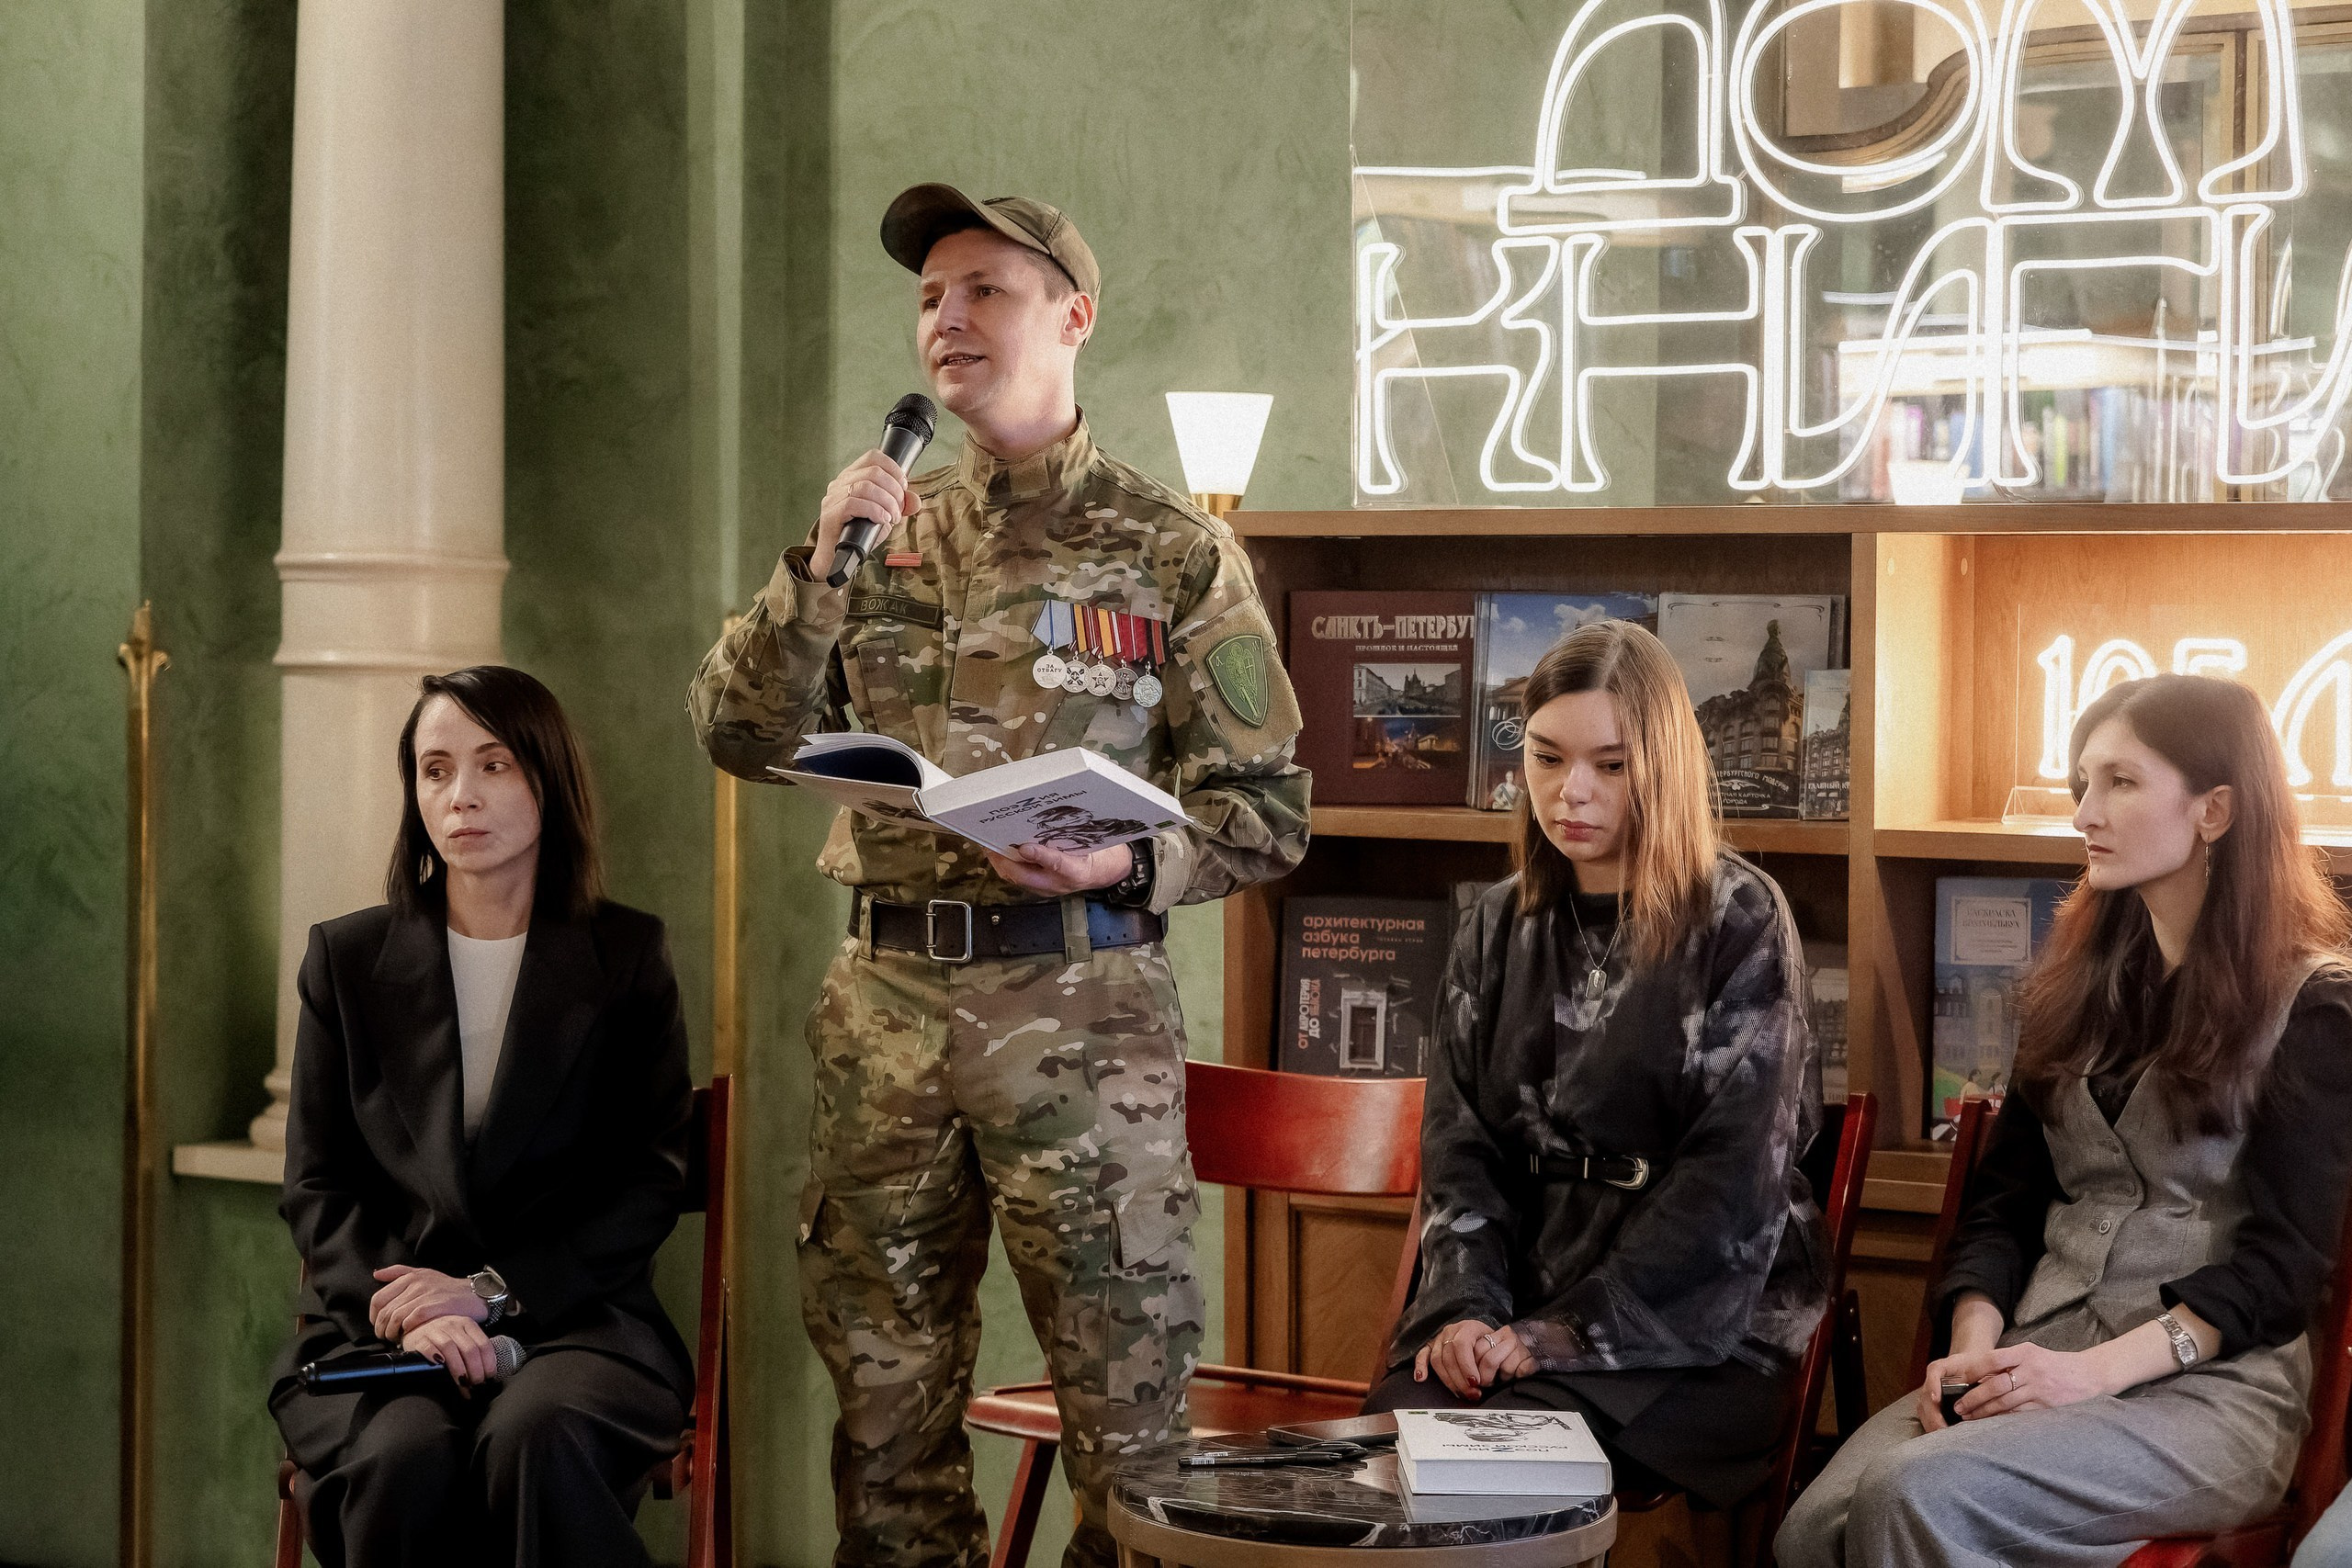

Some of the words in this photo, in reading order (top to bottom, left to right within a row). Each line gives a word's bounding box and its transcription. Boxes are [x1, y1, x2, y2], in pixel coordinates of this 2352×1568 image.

[1498, 0, 2301, 235] ДОМ
[860, 598, 910, 615] ВОЖАК
[1045, 790, 1088, 806] ЗИМЫ
[1303, 916, 1424, 931] архитектурная
[1303, 931, 1360, 944] азбука
[1302, 946, 1396, 963] петербурга
[1308, 1017, 1320, 1039] ДО
[1298, 1032, 1308, 1049] ОТ
